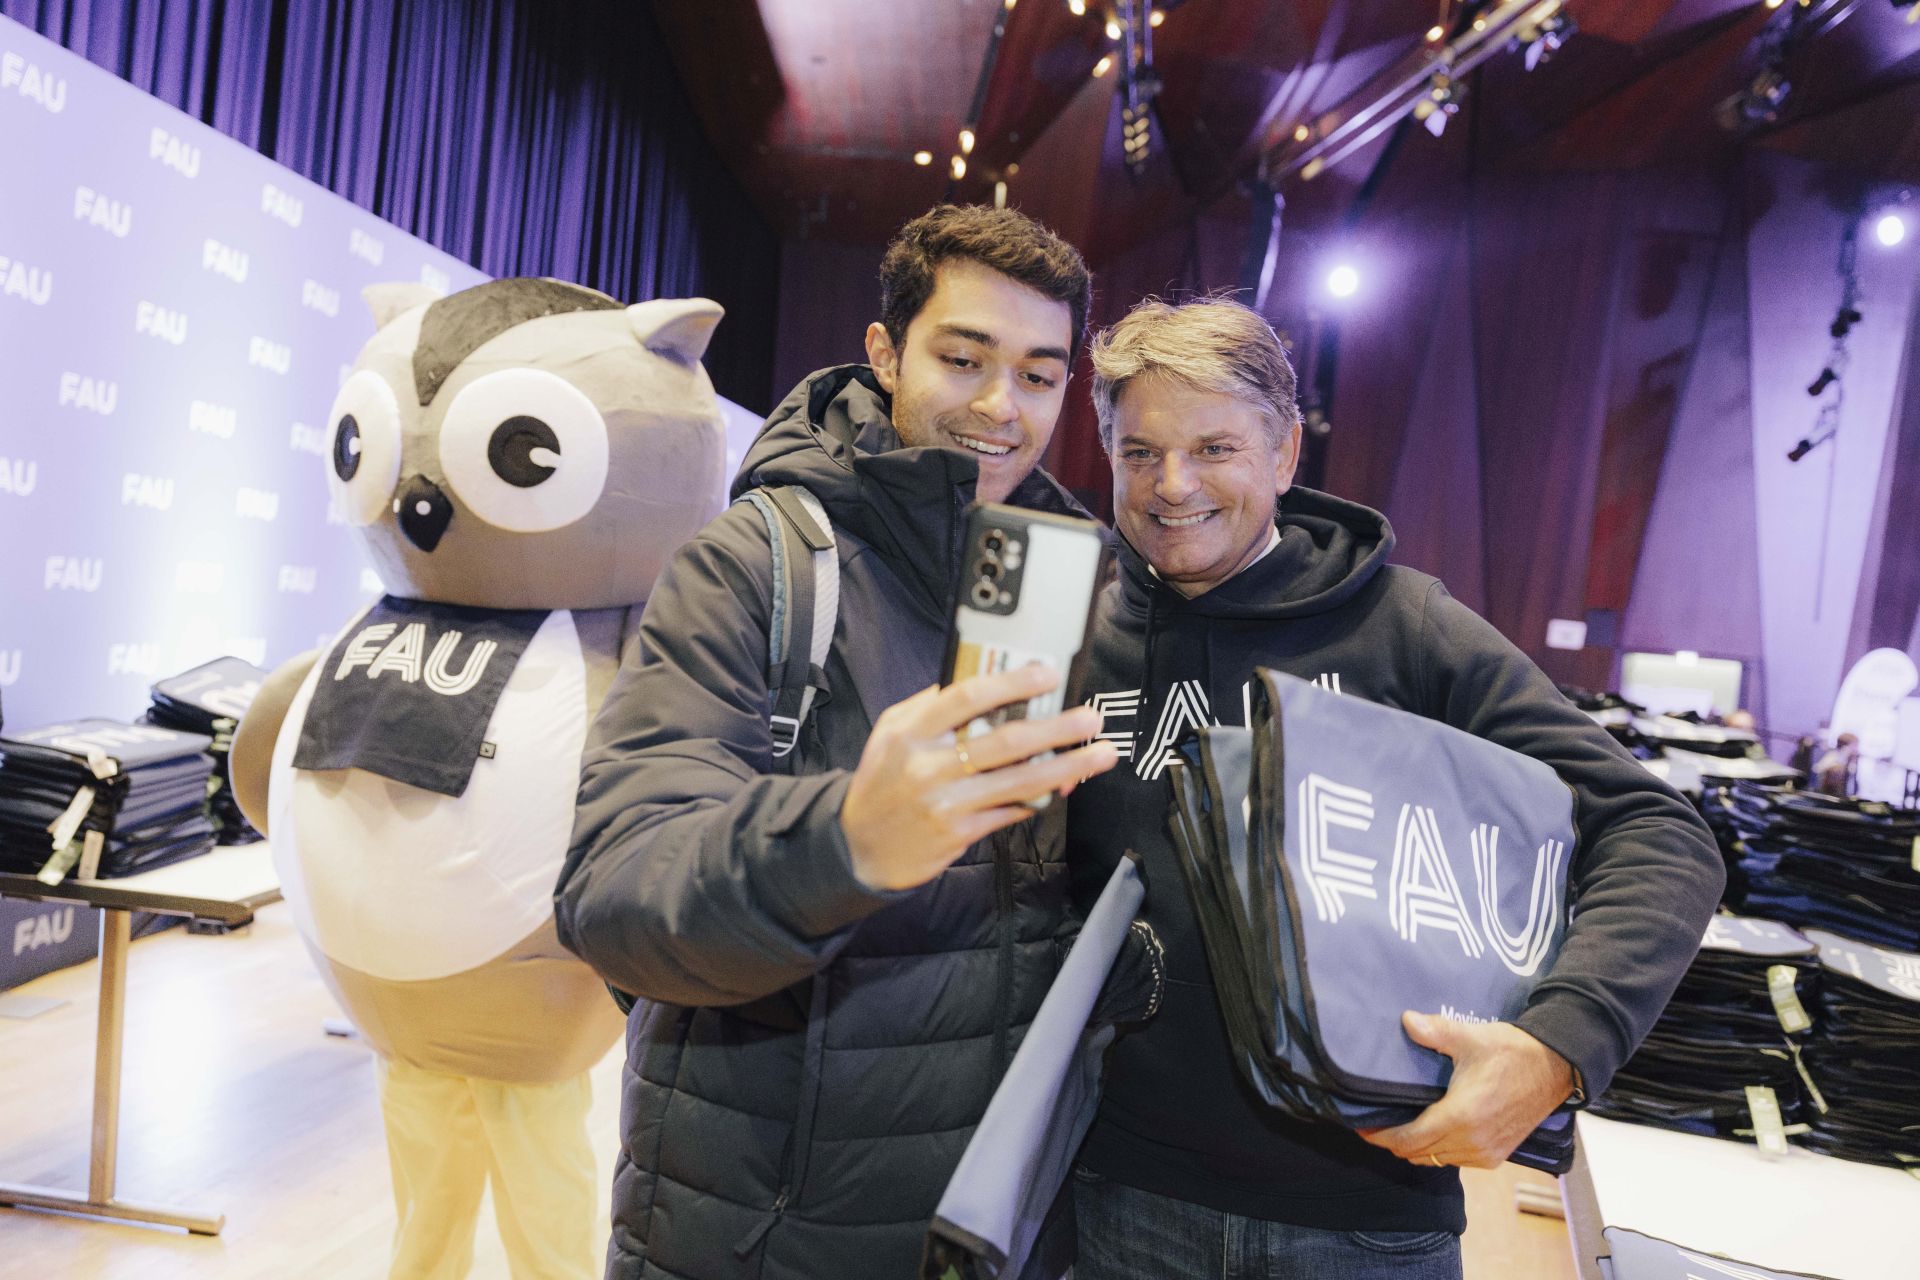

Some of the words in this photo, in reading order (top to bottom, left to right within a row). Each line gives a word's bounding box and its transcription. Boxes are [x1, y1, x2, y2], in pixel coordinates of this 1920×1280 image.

[1, 50, 67, 114] FAU
[149, 126, 201, 179] FAU
[74, 186, 132, 238] FAU
[262, 184, 304, 228] FAU
[203, 239, 249, 284] FAU
[136, 301, 188, 345] FAU
[59, 371, 118, 416] FAU
[121, 472, 175, 511] FAU
[44, 555, 103, 592] FAU
[334, 623, 498, 696] FAU
[1081, 672, 1341, 784] FA
[1299, 772, 1563, 977] FAU
[13, 907, 74, 956] FAU
